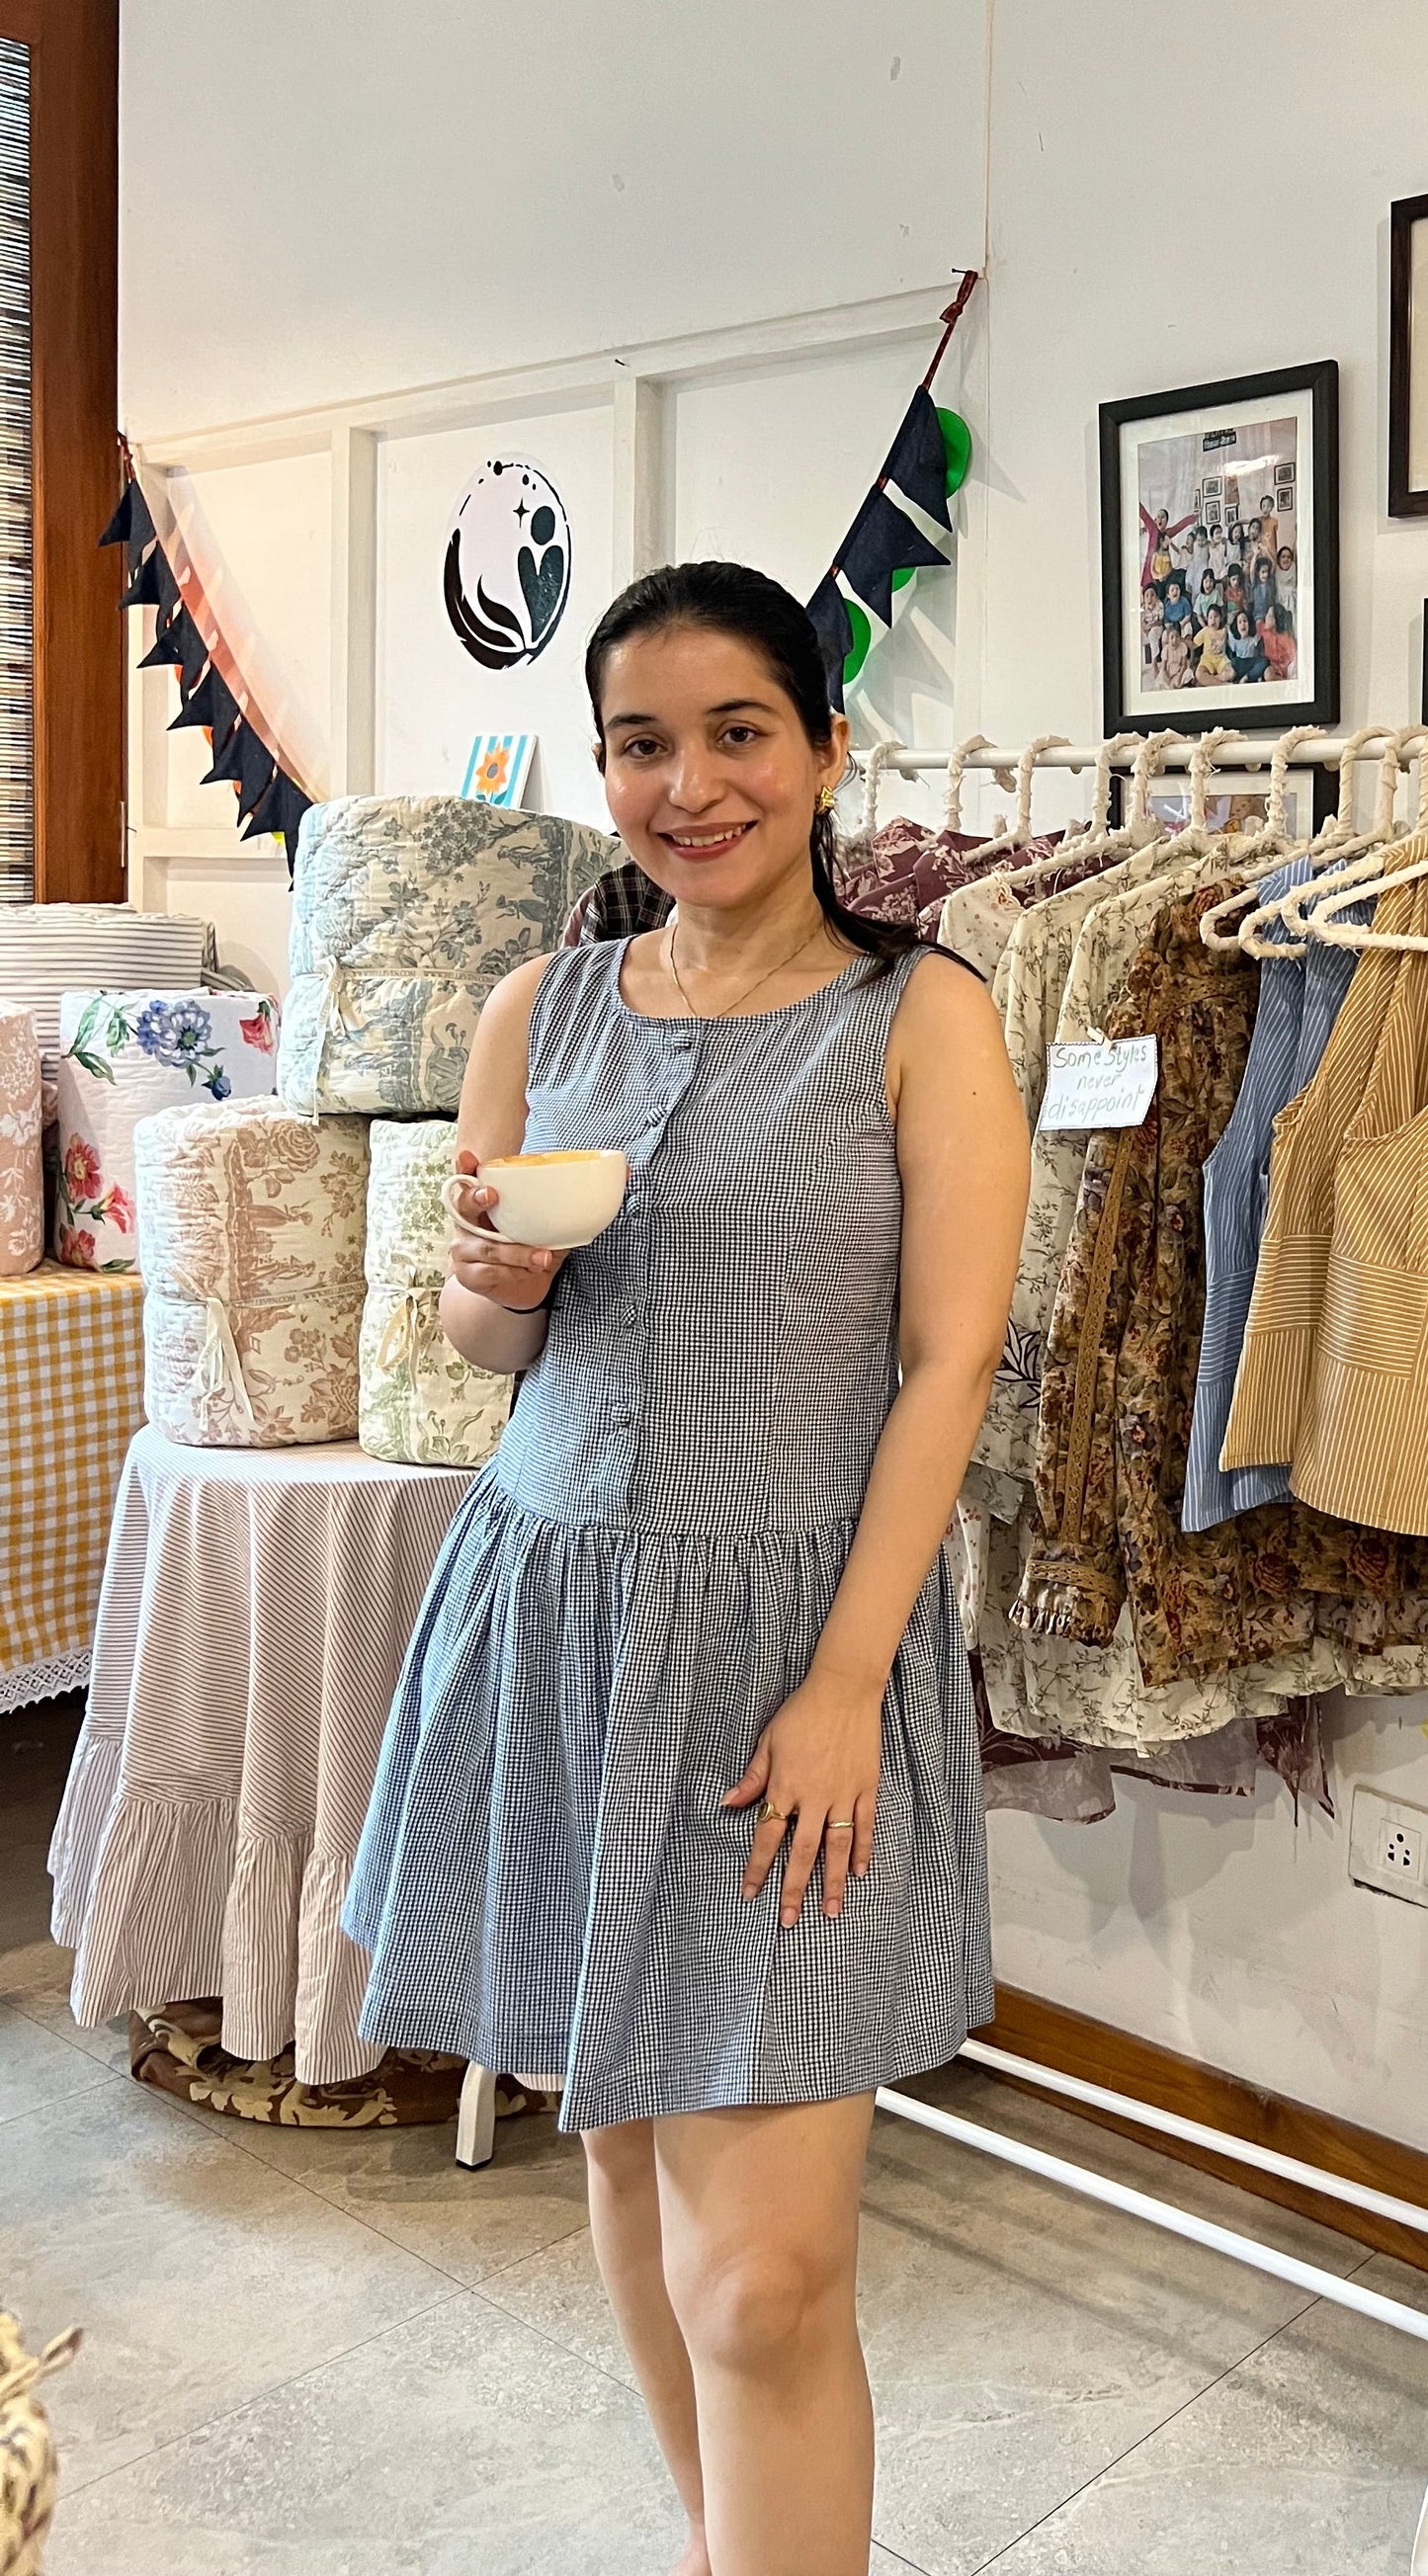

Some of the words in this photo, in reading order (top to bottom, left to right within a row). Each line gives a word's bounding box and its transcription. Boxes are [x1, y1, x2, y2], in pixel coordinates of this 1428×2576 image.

[1053, 1047, 1102, 1068] Some
[1076, 1074, 1123, 1091] never
[1048, 1084, 1145, 1123] disappoint
